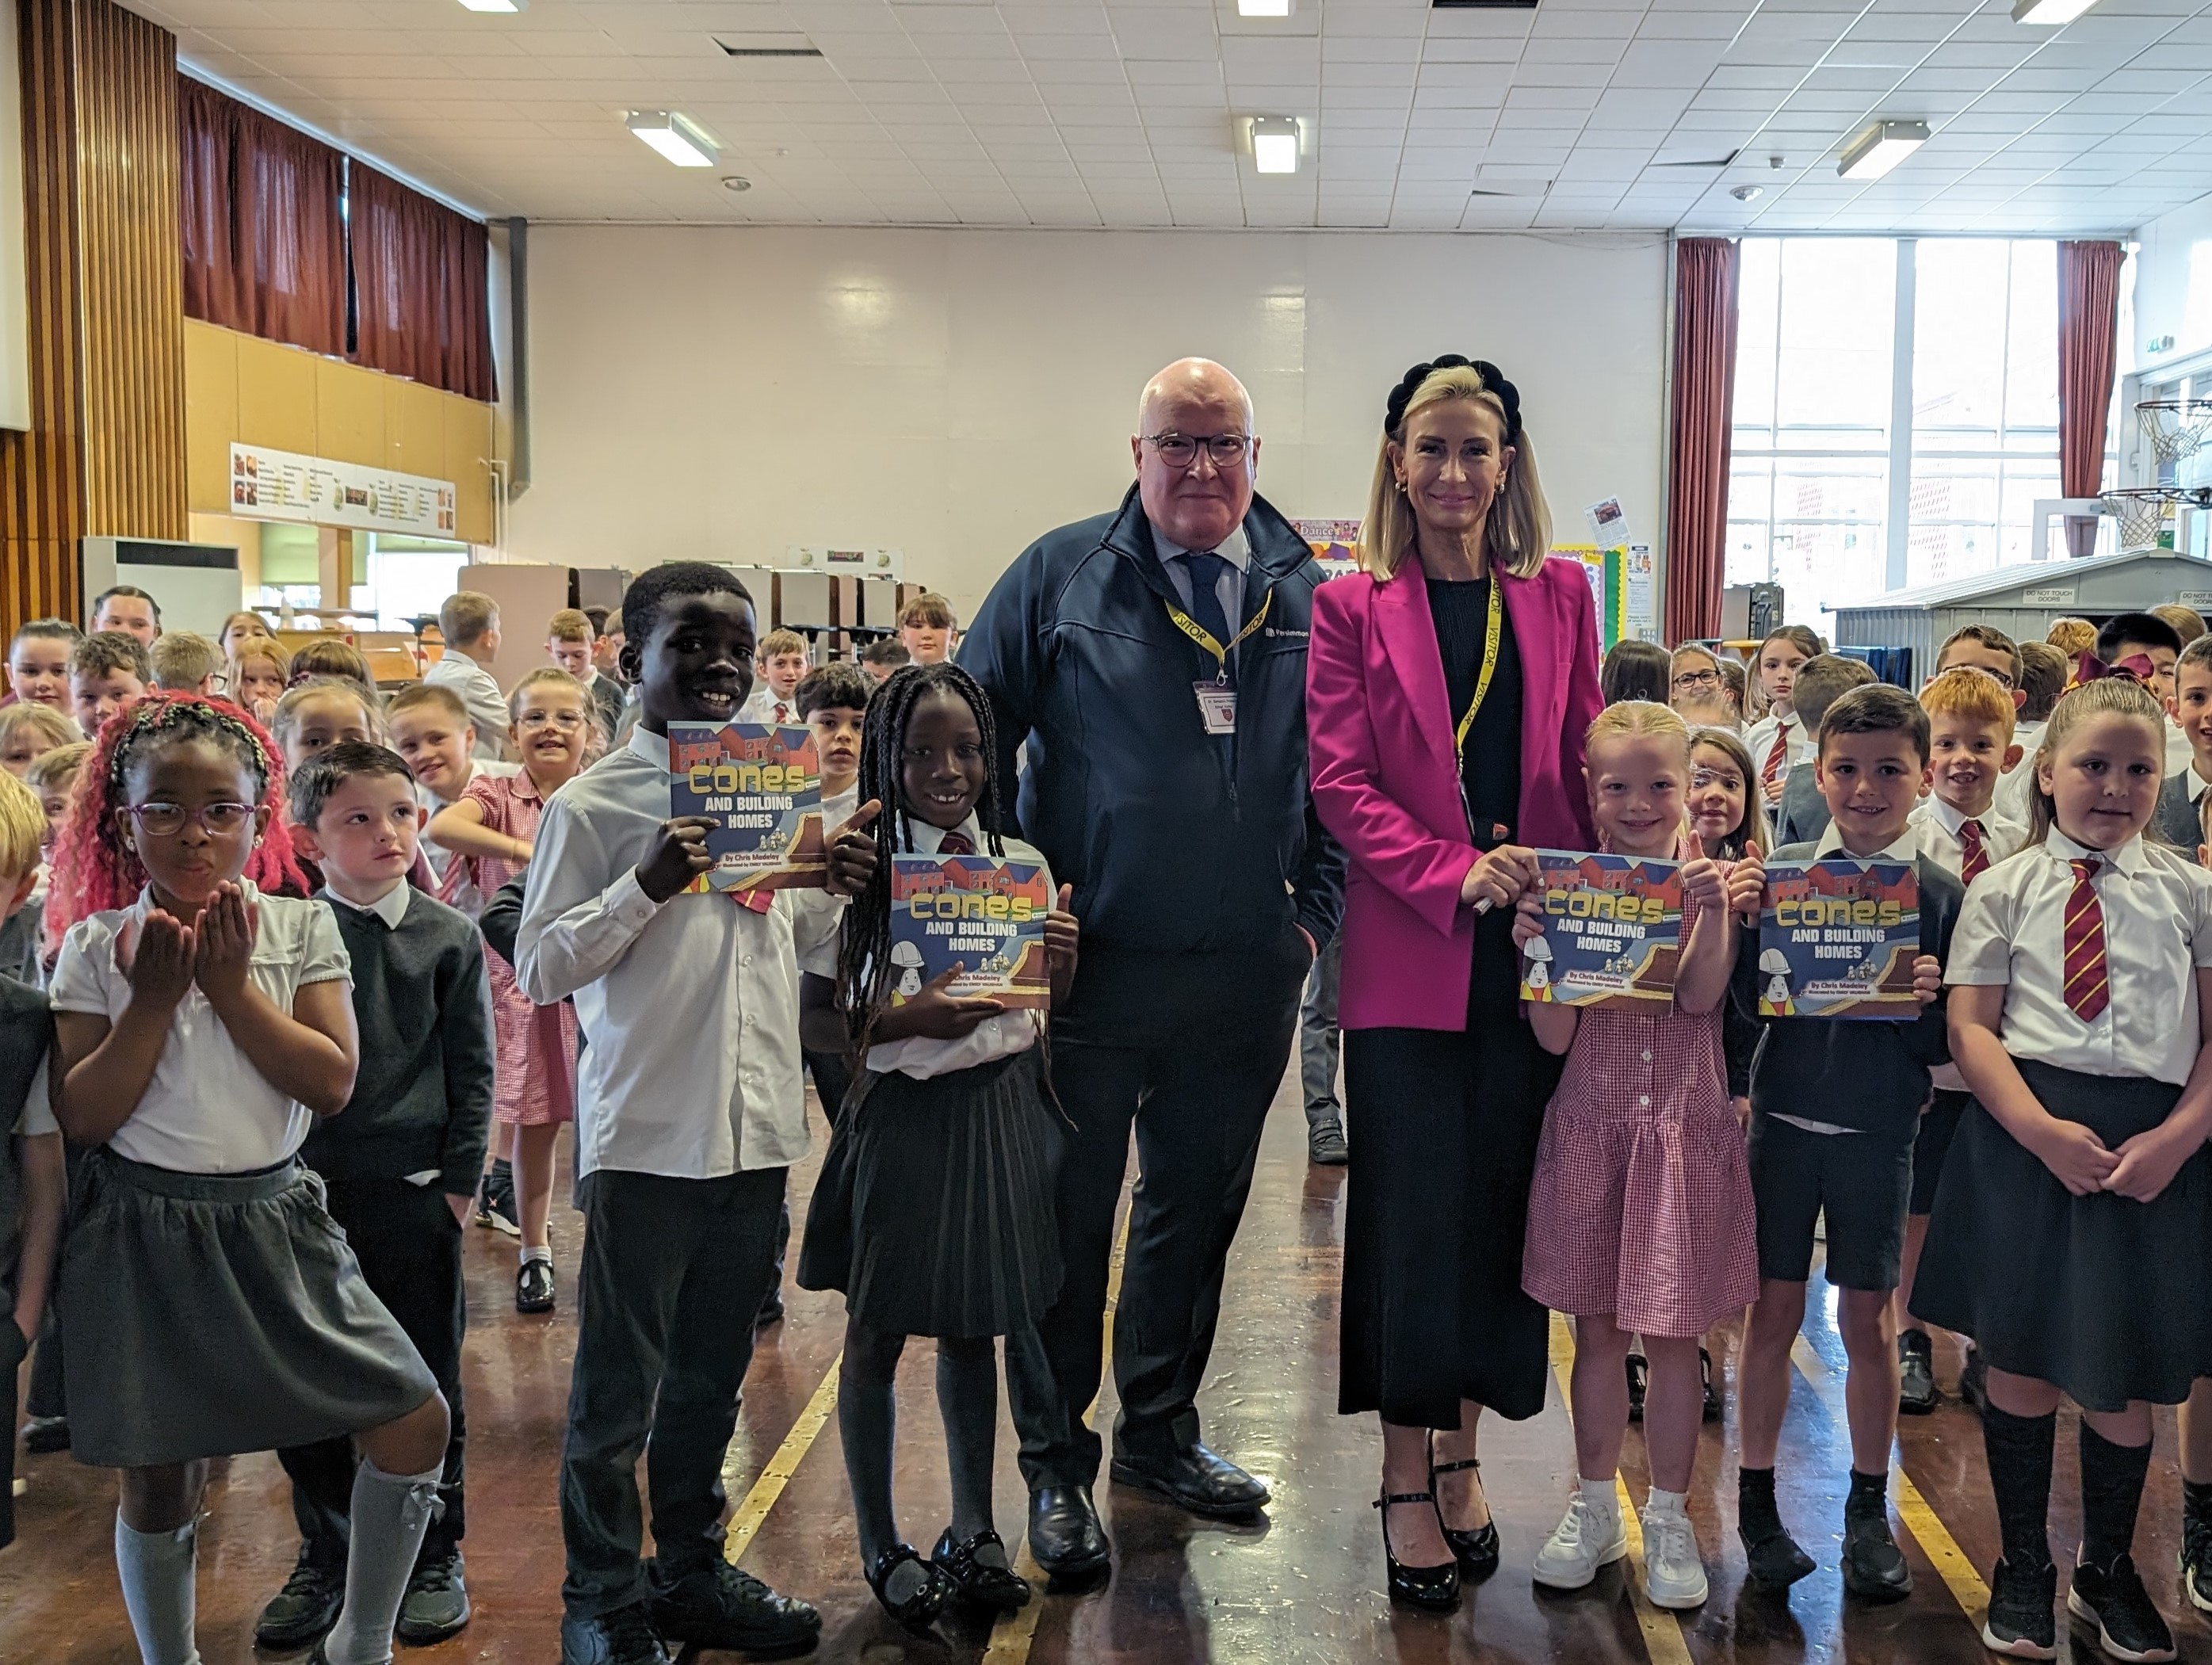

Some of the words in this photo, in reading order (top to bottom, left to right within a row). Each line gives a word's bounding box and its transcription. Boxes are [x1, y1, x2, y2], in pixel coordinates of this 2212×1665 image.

[1301, 525, 1334, 537] Dance
[1484, 628, 1499, 667] VISITOR
[1465, 682, 1488, 725] VISITOR
[705, 797, 732, 811] AND
[737, 796, 793, 811] BUILDING
[728, 814, 774, 829] HOMES
[926, 922, 953, 935] AND
[958, 922, 1018, 937] BUILDING
[1557, 918, 1584, 934] AND
[1587, 922, 1646, 940] BUILDING
[1792, 929, 1820, 943] AND
[1824, 929, 1885, 943] BUILDING
[949, 938, 995, 952] HOMES
[1576, 937, 1622, 953] HOMES
[1815, 945, 1862, 959] HOMES
[1595, 975, 1623, 983] Madeley
